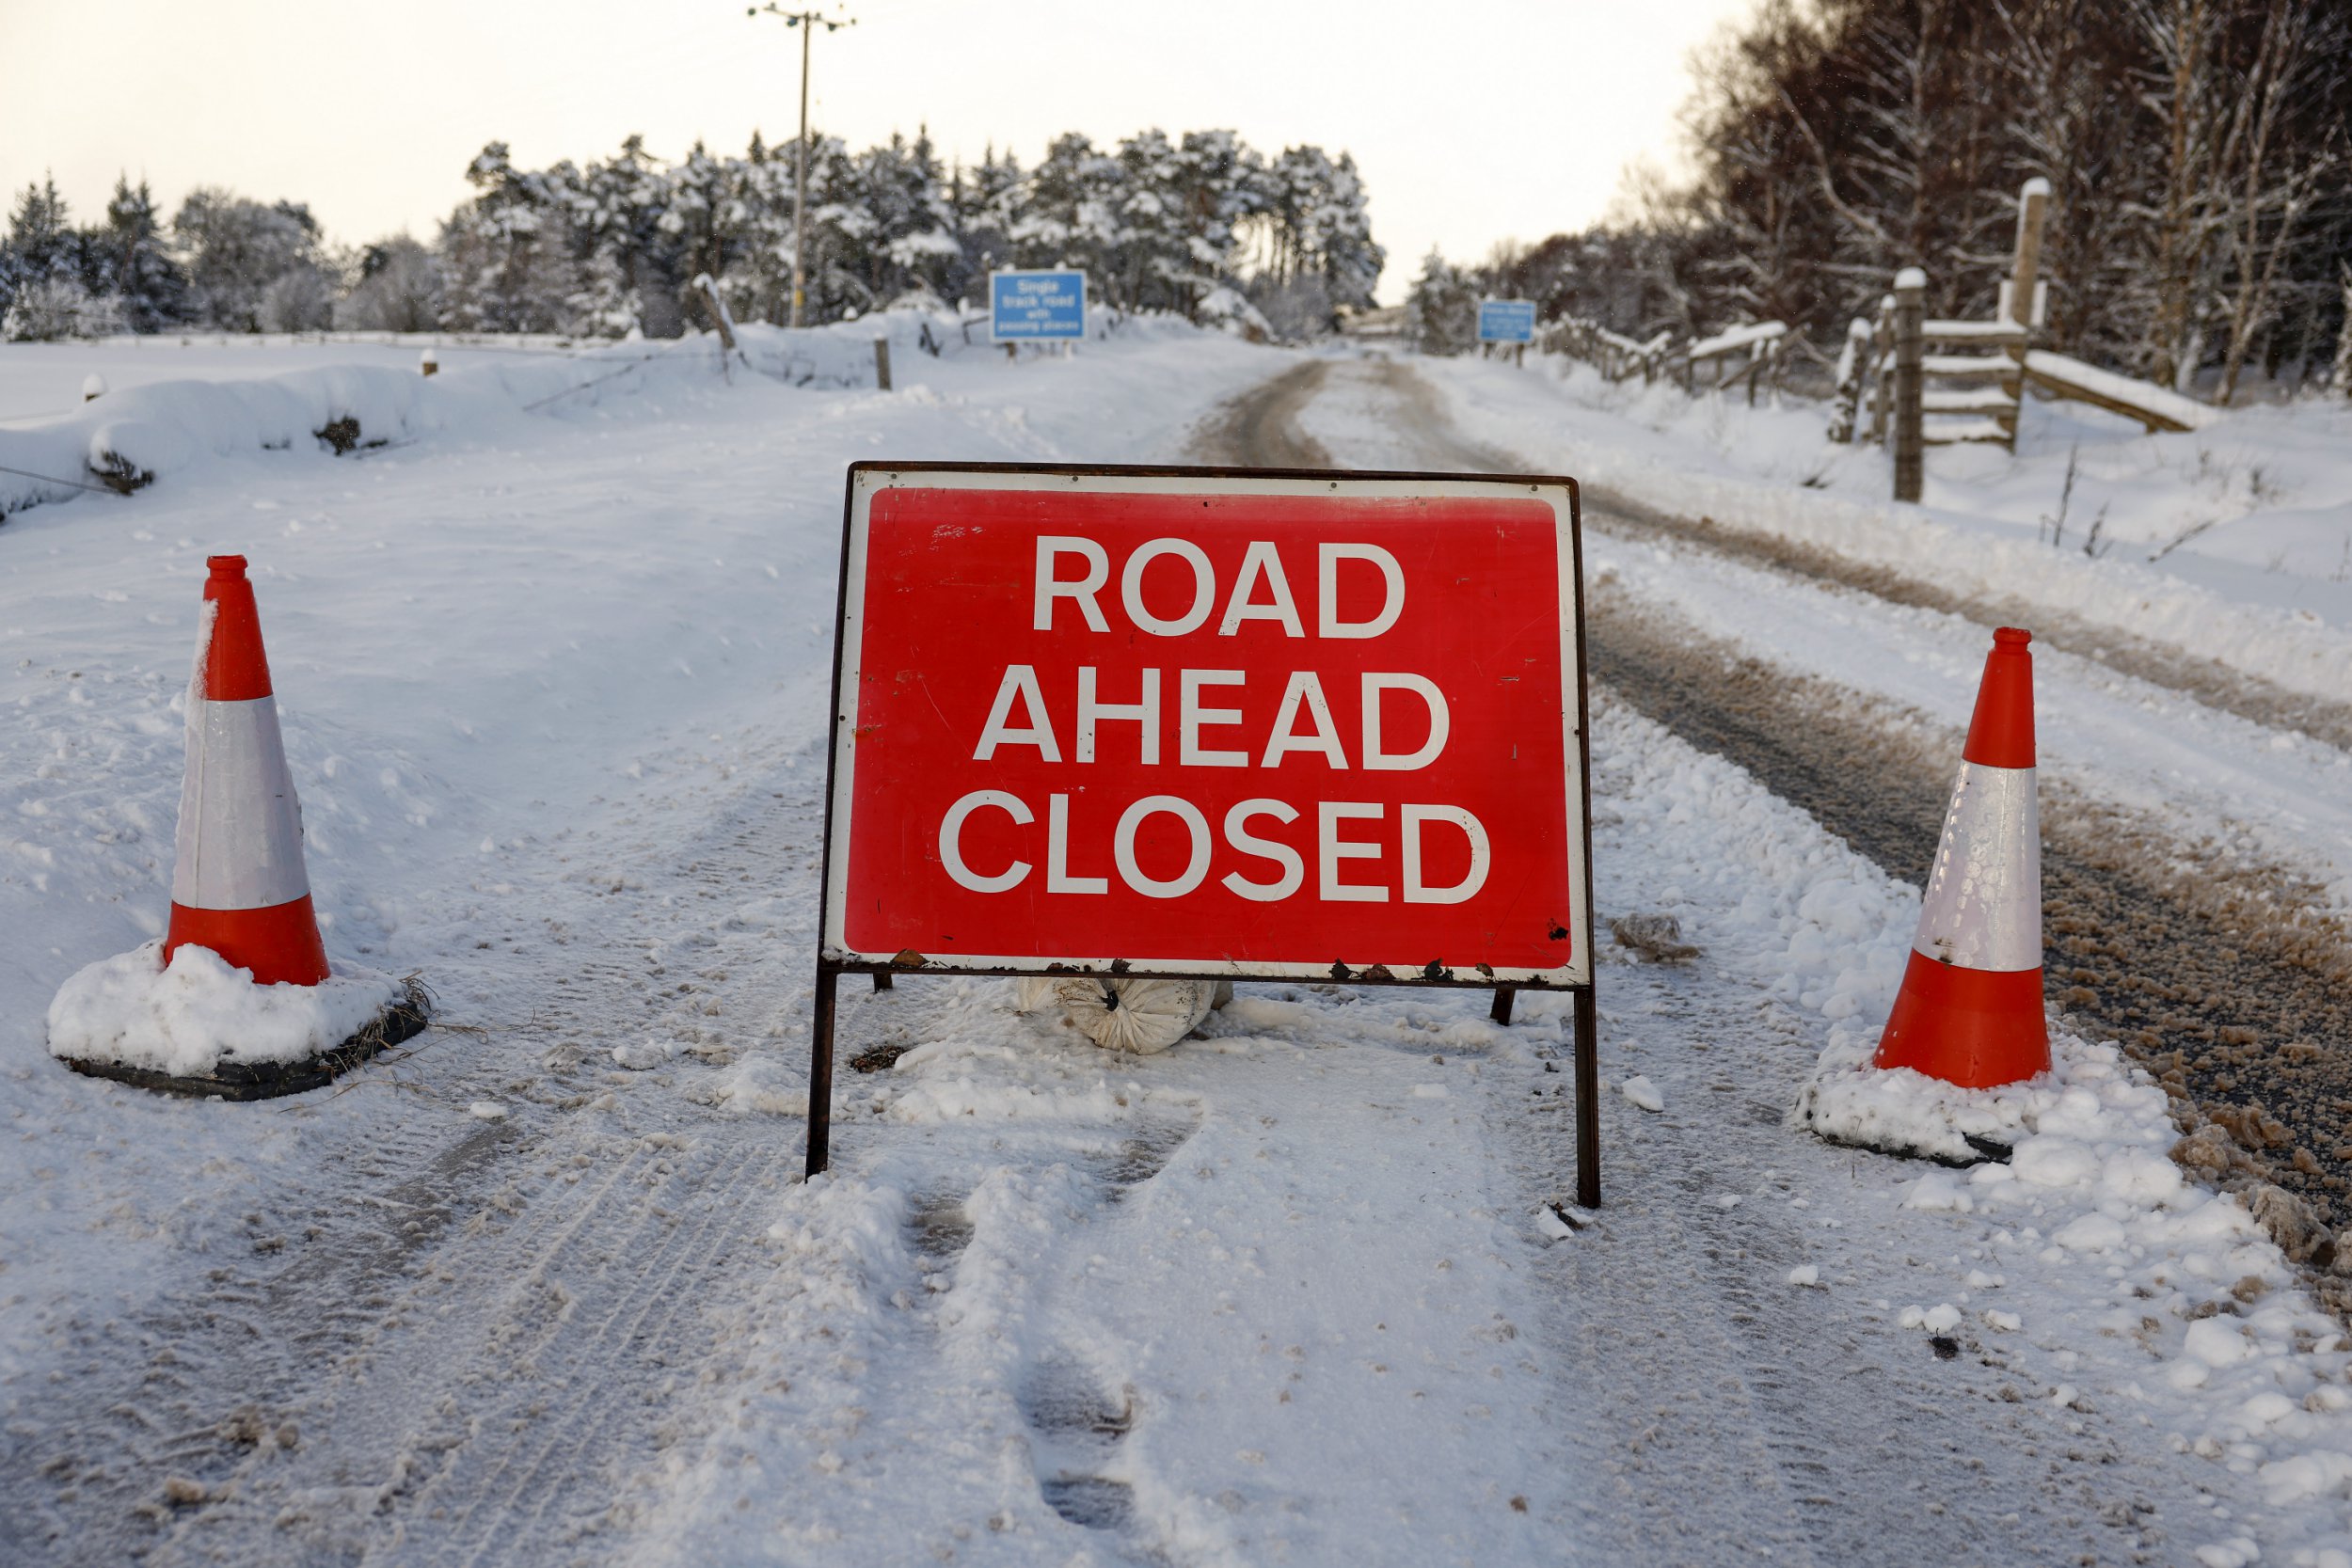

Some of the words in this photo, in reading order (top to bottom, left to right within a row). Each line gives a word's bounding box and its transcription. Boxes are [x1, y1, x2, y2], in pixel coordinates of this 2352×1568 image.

[1016, 279, 1060, 294] Single
[1002, 294, 1039, 308] track
[1042, 294, 1075, 308] road
[1026, 309, 1051, 319] with
[999, 321, 1040, 332] passing
[1041, 320, 1079, 332] places
[1034, 536, 1405, 639] ROAD
[973, 665, 1449, 770] AHEAD
[939, 790, 1490, 904] CLOSED
